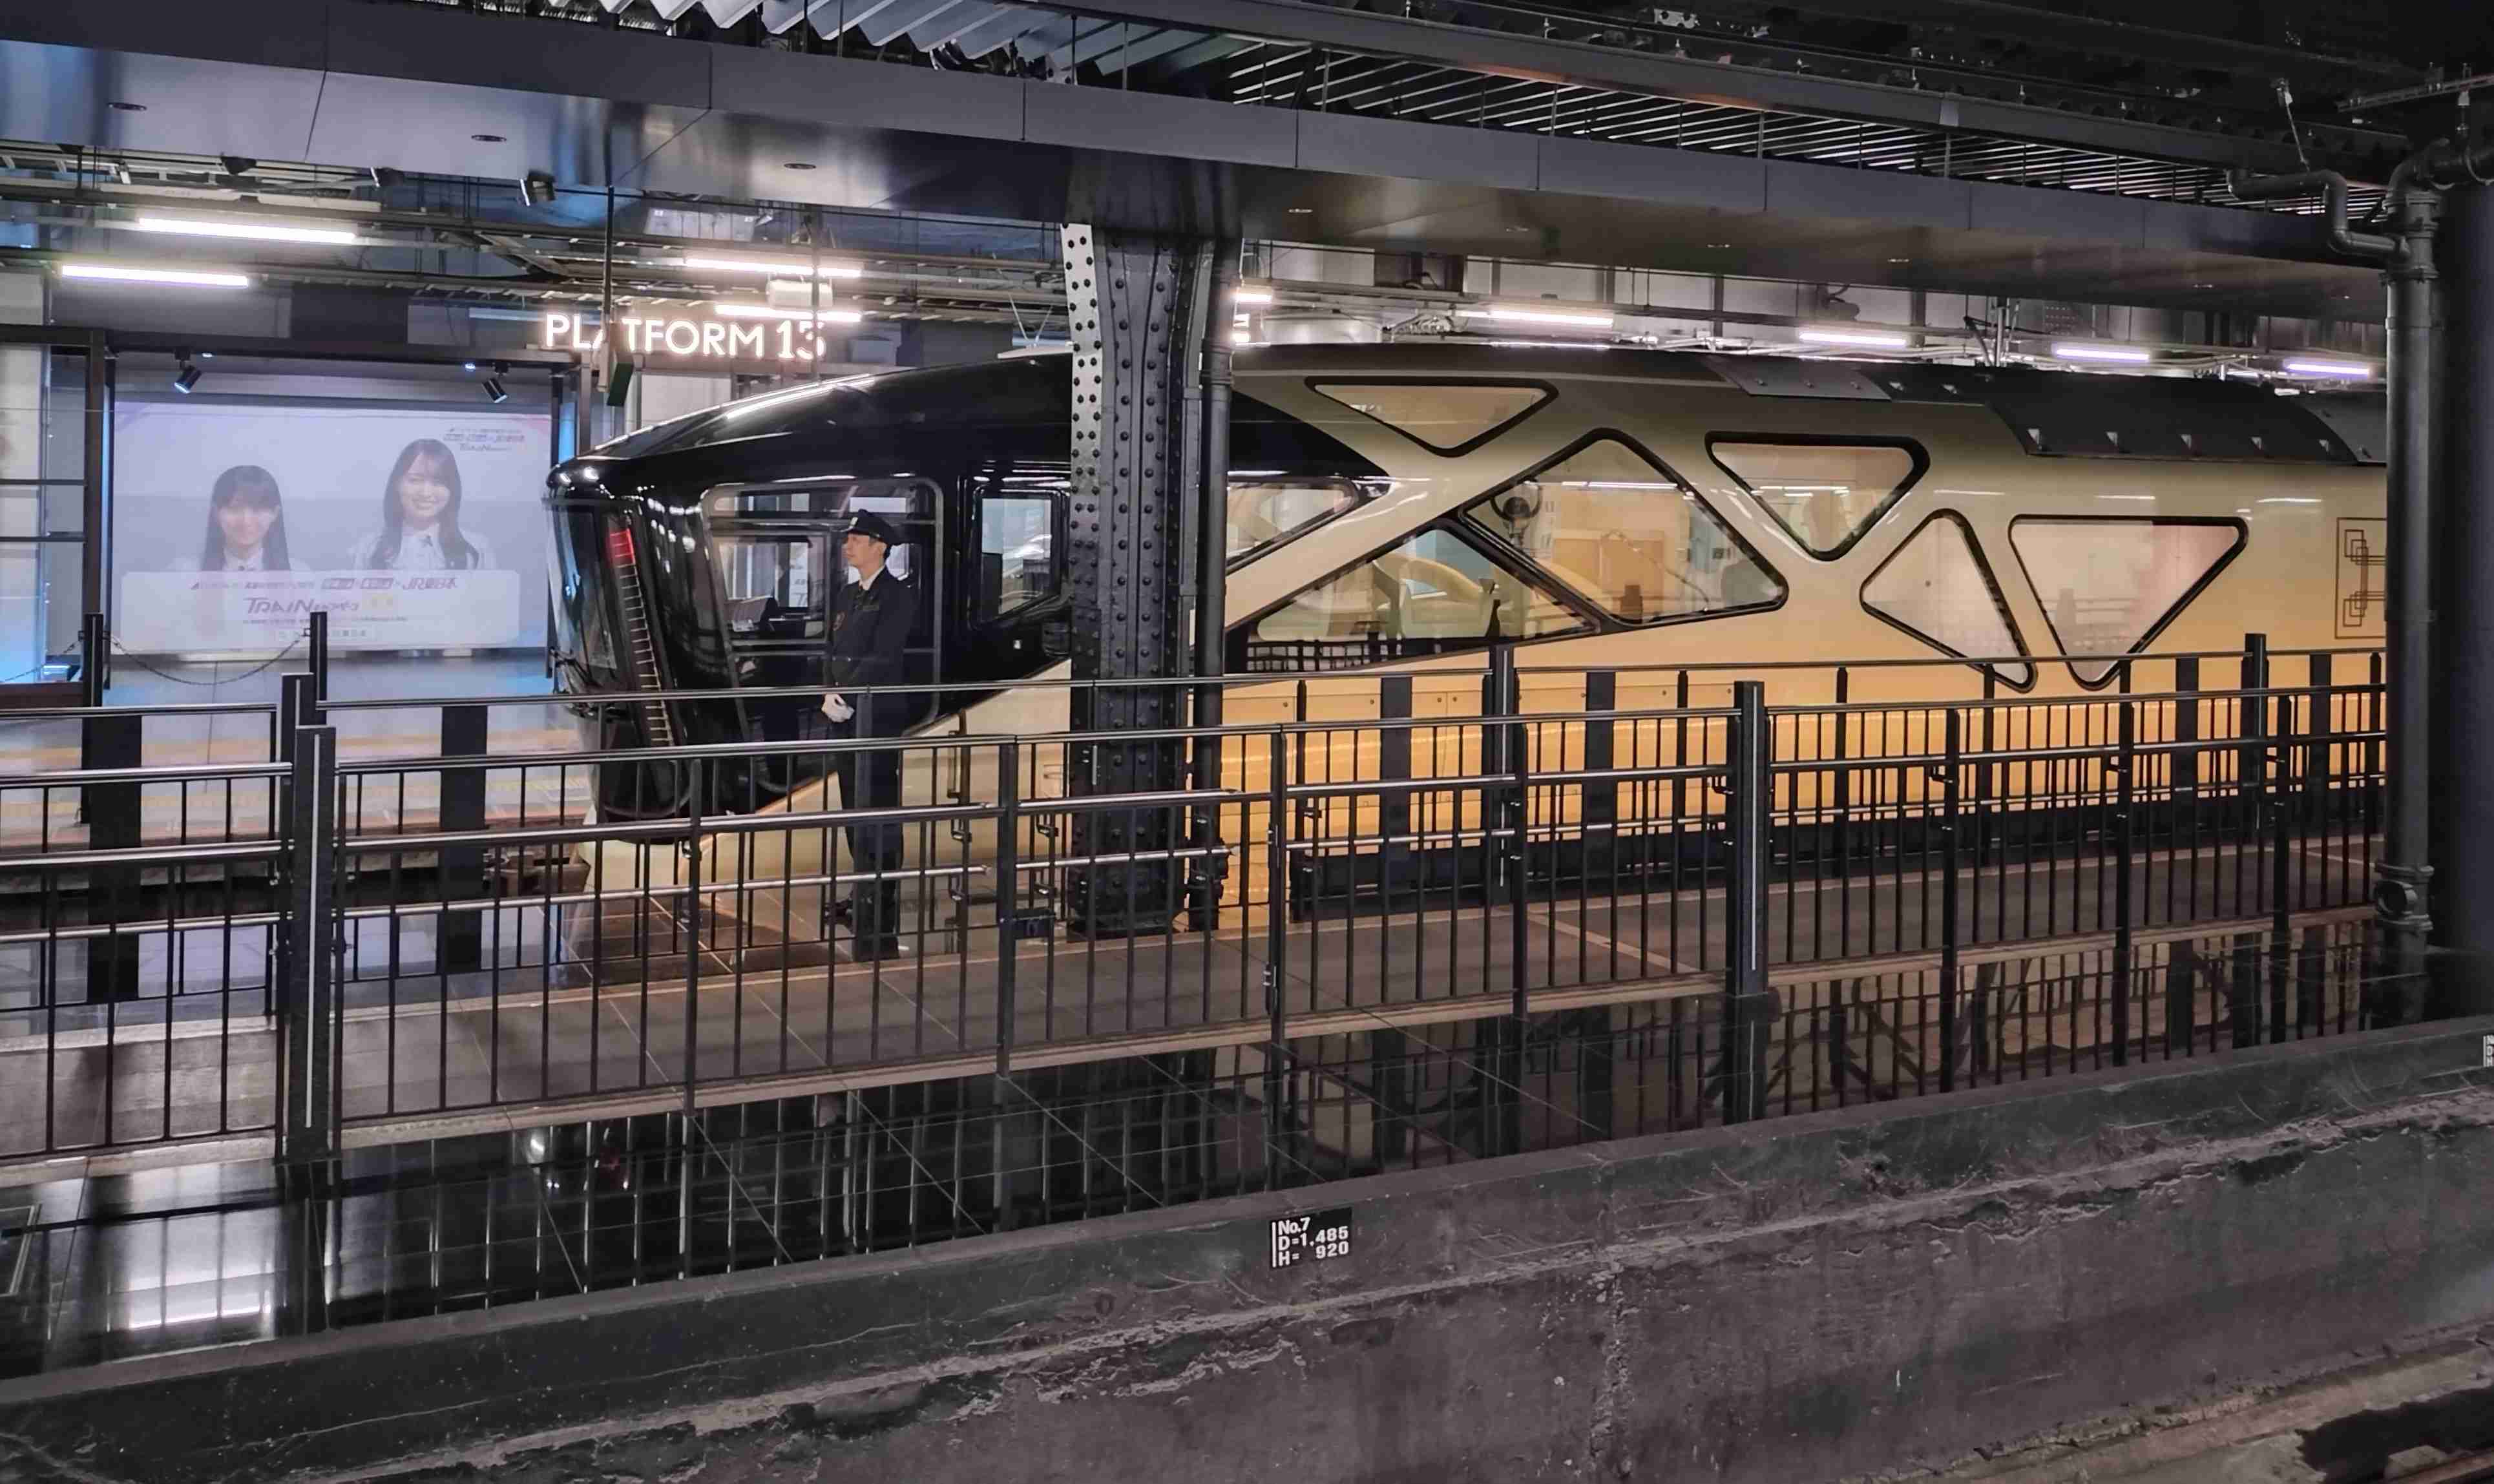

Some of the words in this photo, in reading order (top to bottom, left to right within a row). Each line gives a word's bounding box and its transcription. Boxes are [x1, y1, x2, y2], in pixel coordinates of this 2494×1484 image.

[1277, 1217, 1311, 1235] No.7
[1278, 1226, 1349, 1251] D=1.485
[1315, 1240, 1349, 1259] 920
